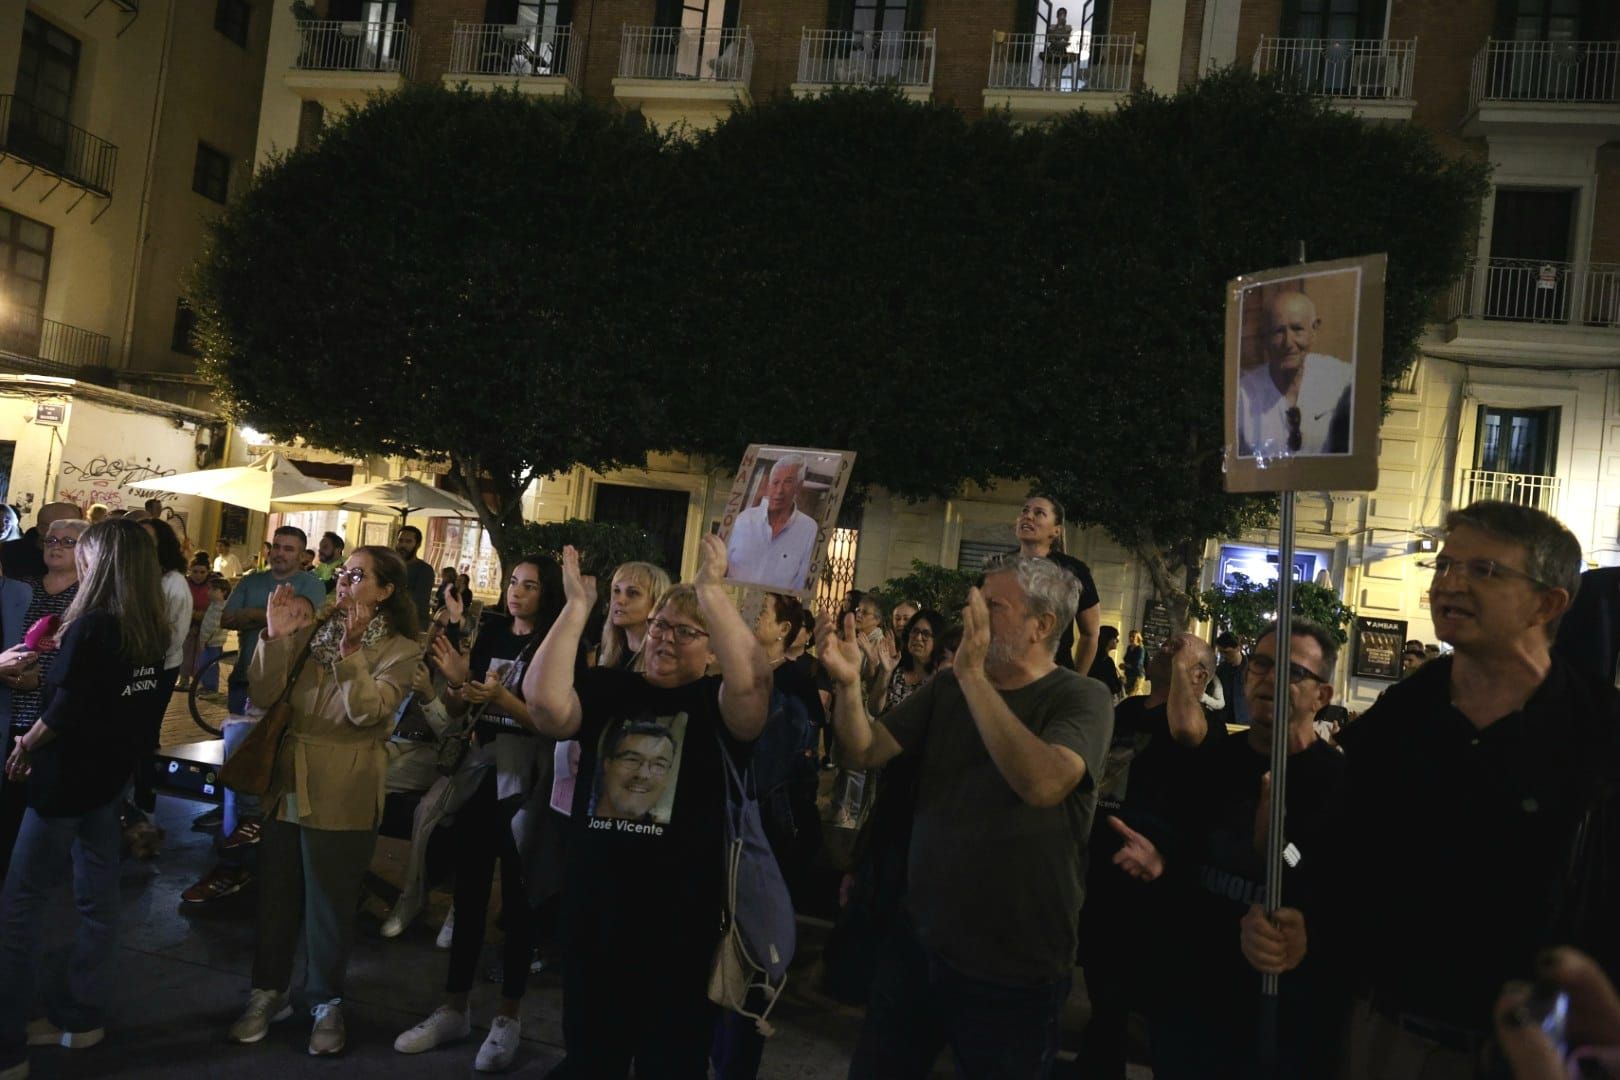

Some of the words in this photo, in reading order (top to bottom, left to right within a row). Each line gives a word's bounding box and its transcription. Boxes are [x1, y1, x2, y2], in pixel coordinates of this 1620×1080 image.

[804, 460, 848, 592] DIMISIÓN
[587, 816, 613, 830] José
[616, 819, 664, 837] Vicente
